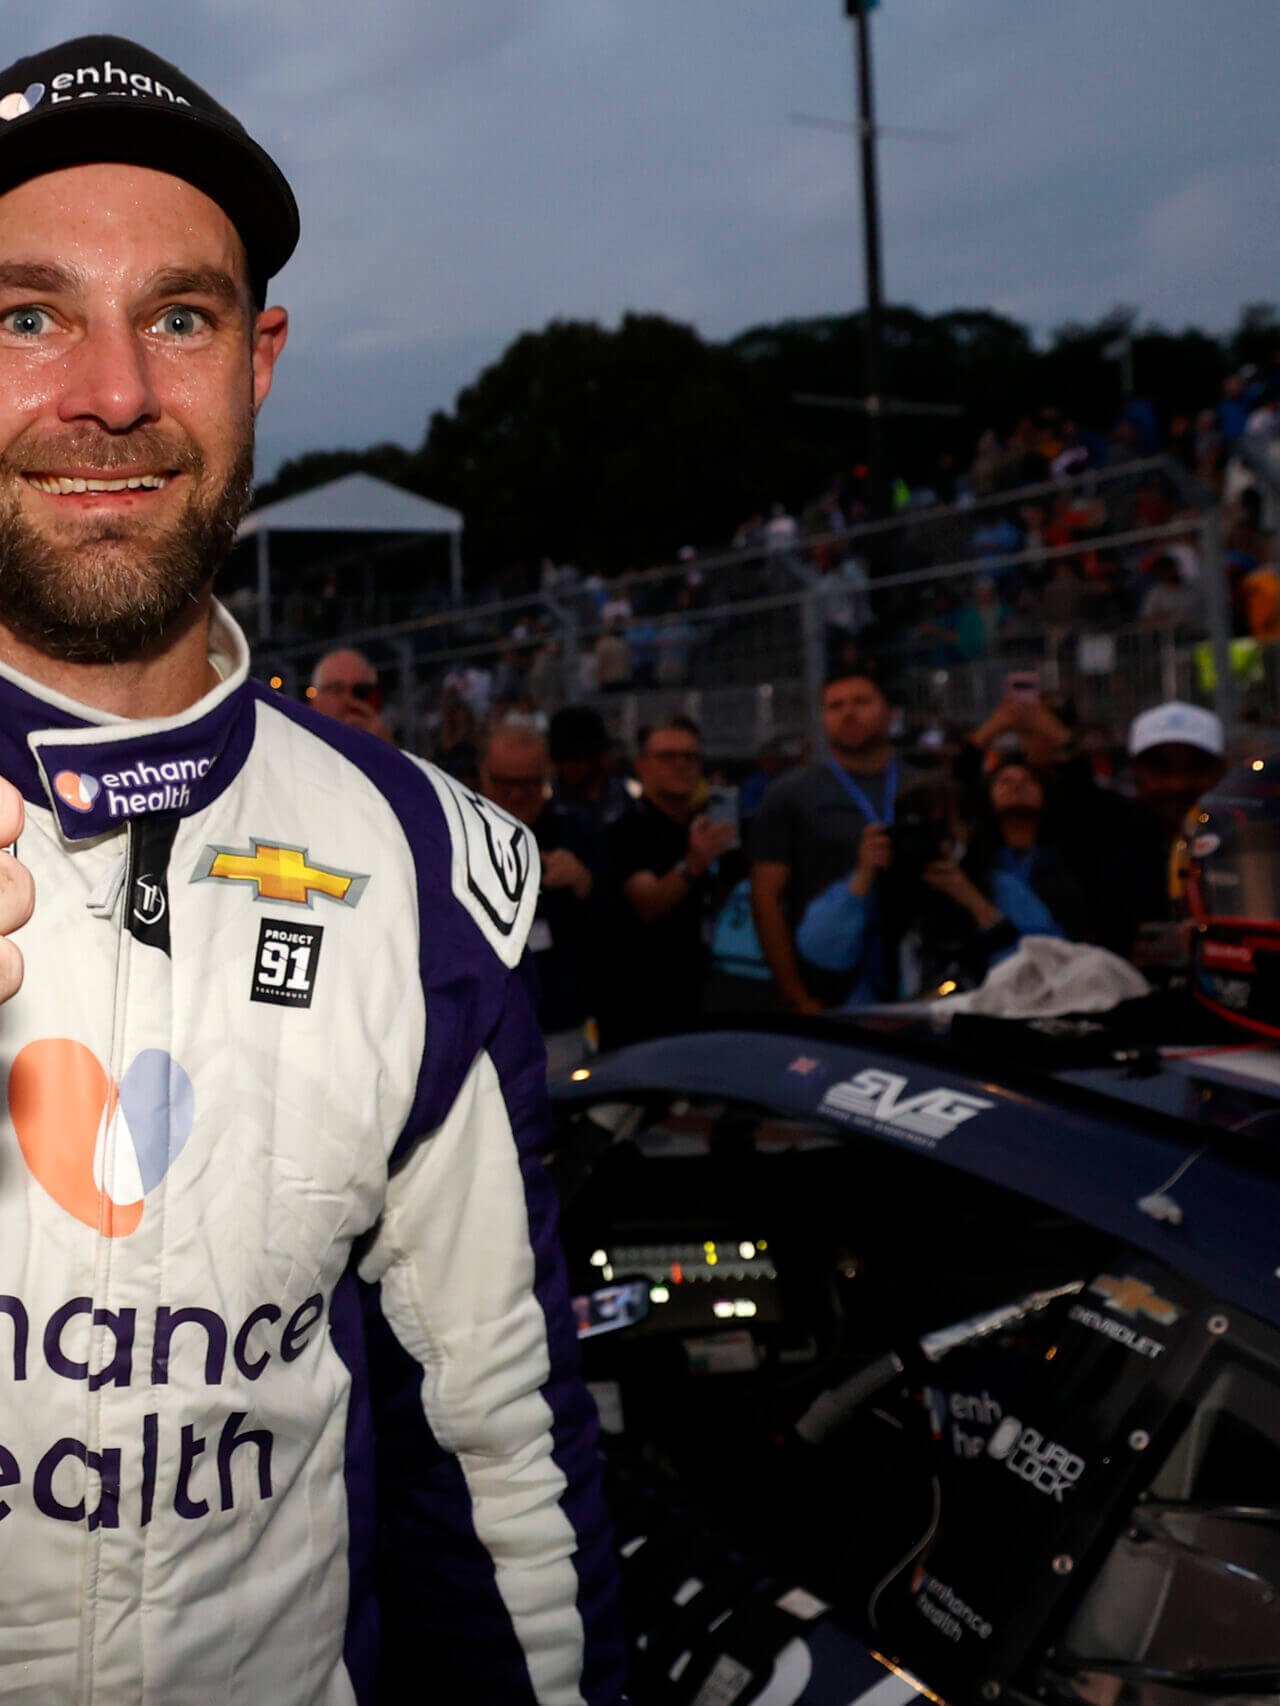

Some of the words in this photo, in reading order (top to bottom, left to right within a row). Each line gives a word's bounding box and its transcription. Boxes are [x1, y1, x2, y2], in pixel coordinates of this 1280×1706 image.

[105, 784, 191, 816] health
[265, 929, 314, 945] PROJECT
[257, 941, 312, 991] 91
[822, 1066, 996, 1141] SVG
[1005, 1447, 1074, 1504] LOCK
[1017, 1426, 1086, 1482] QUAD
